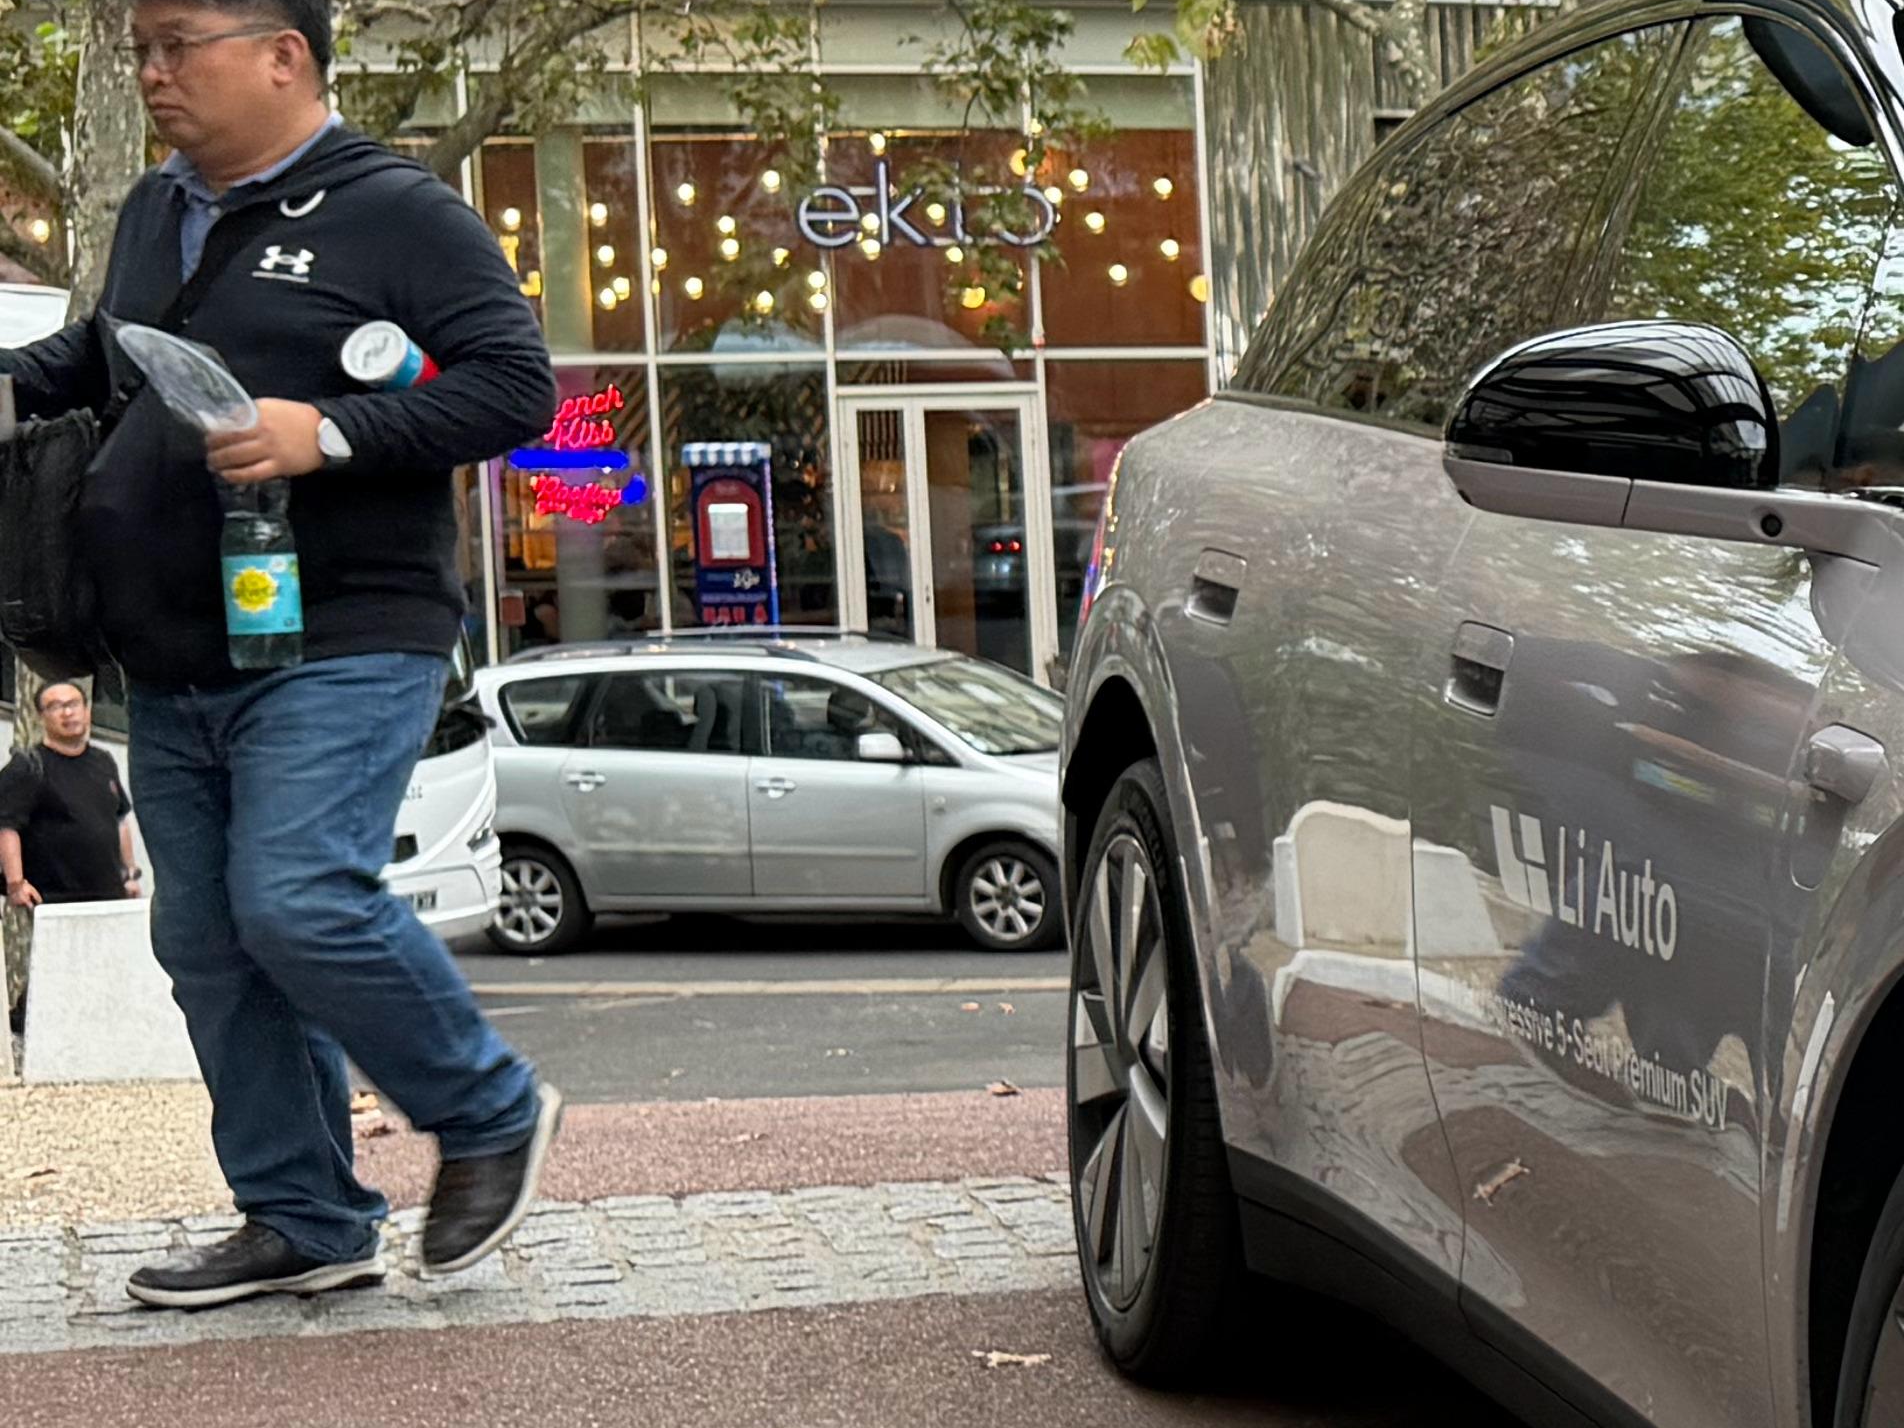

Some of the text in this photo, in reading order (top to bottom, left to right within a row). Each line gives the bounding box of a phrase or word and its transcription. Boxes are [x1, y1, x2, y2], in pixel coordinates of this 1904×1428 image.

[554, 383, 625, 422] ench
[1558, 825, 1677, 961] Li Auto
[1614, 1034, 1688, 1115] Premium
[1691, 1069, 1729, 1131] SUV
